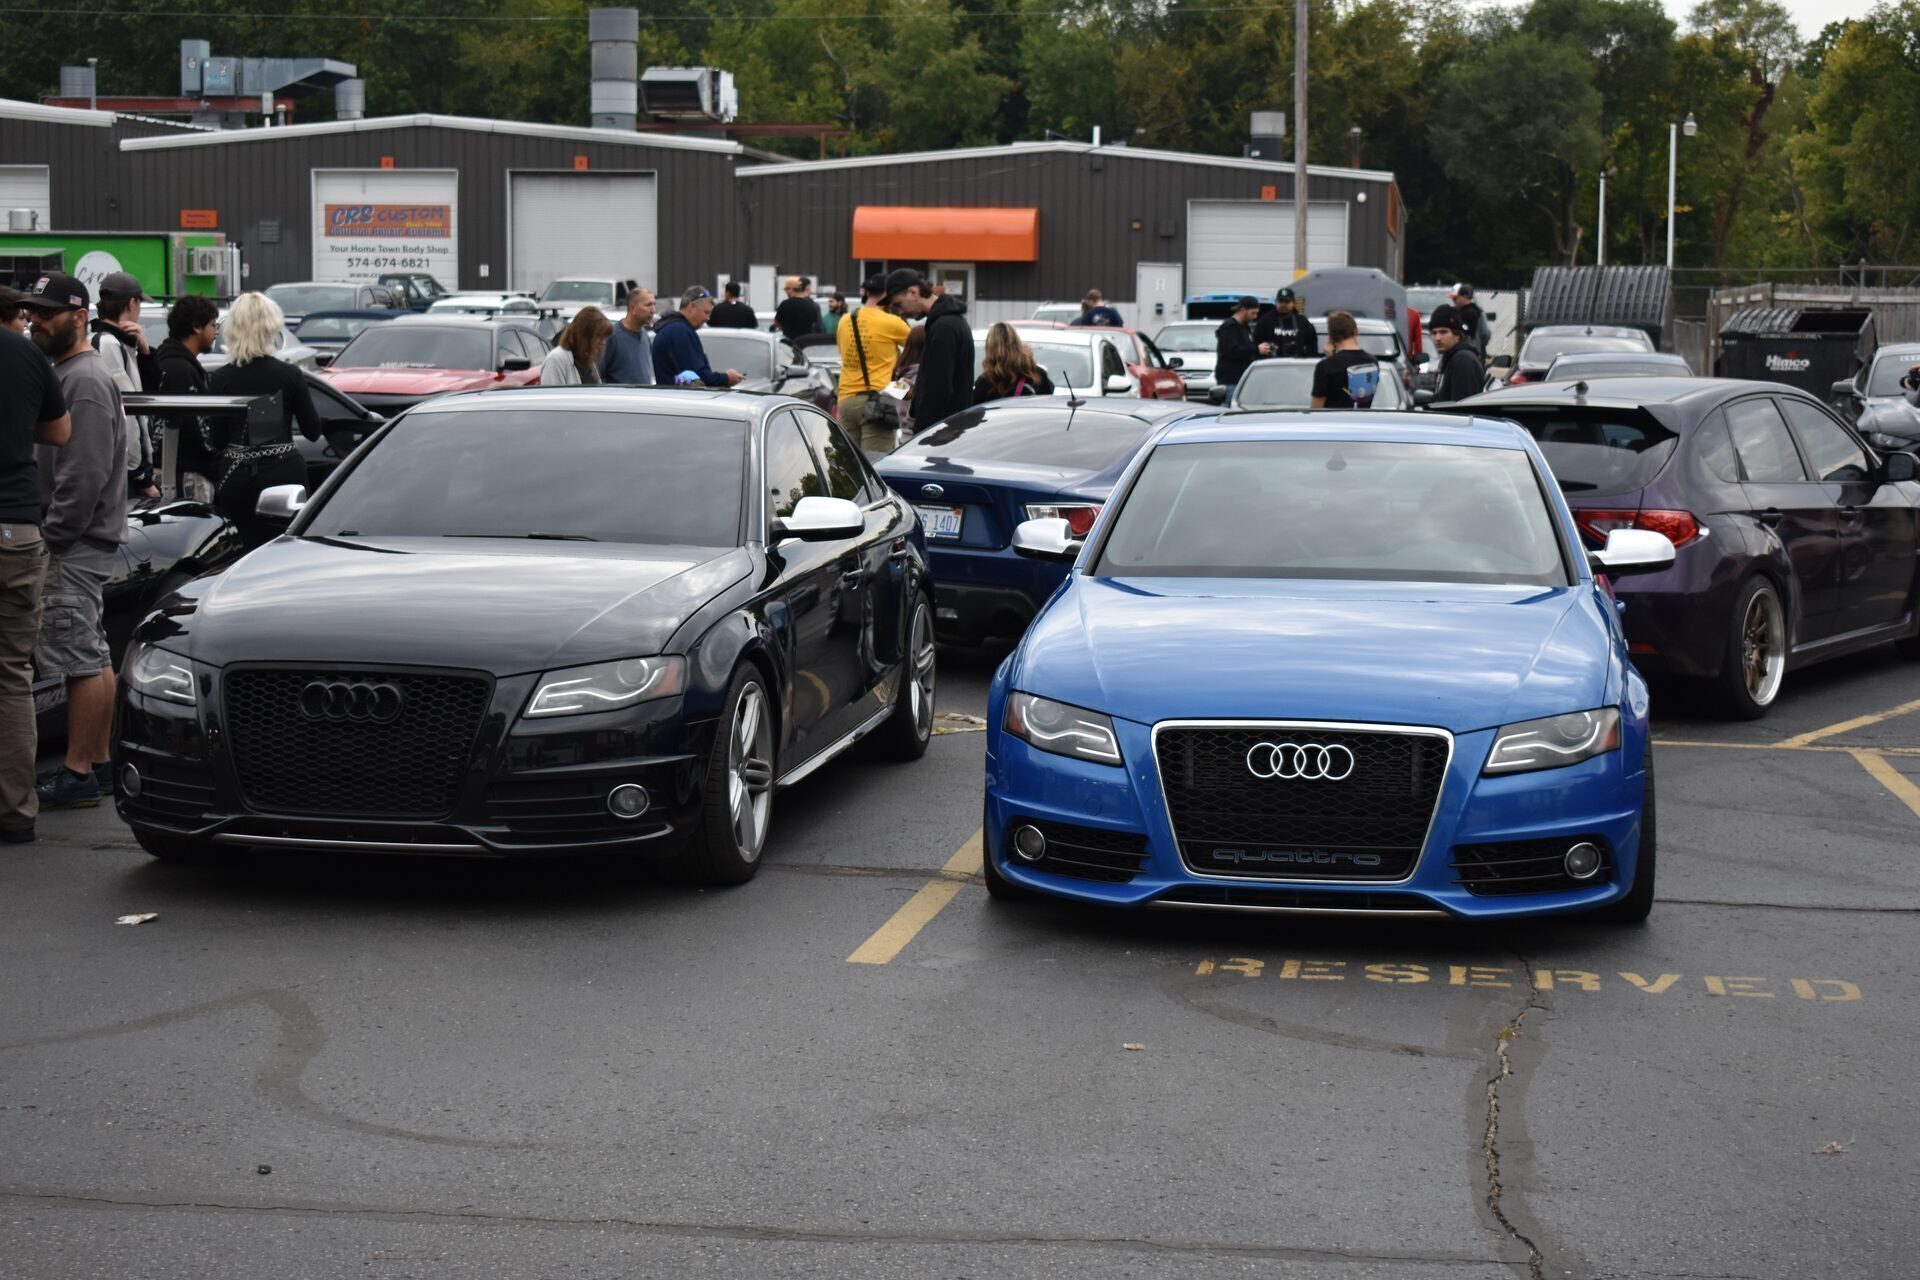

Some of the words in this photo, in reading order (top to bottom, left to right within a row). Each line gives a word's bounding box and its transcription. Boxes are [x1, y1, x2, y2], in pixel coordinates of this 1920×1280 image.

[331, 205, 375, 226] CRS
[377, 207, 444, 222] CUSTOM
[330, 245, 349, 253] Your
[351, 245, 377, 253] Home
[379, 245, 401, 253] Town
[402, 245, 425, 254] Body
[426, 246, 449, 255] Shop
[347, 258, 430, 268] 574-674-6821
[1765, 354, 1810, 367] Himco
[933, 514, 959, 532] 1407
[1213, 849, 1381, 866] quattro
[1195, 958, 1863, 1000] RESERVED
